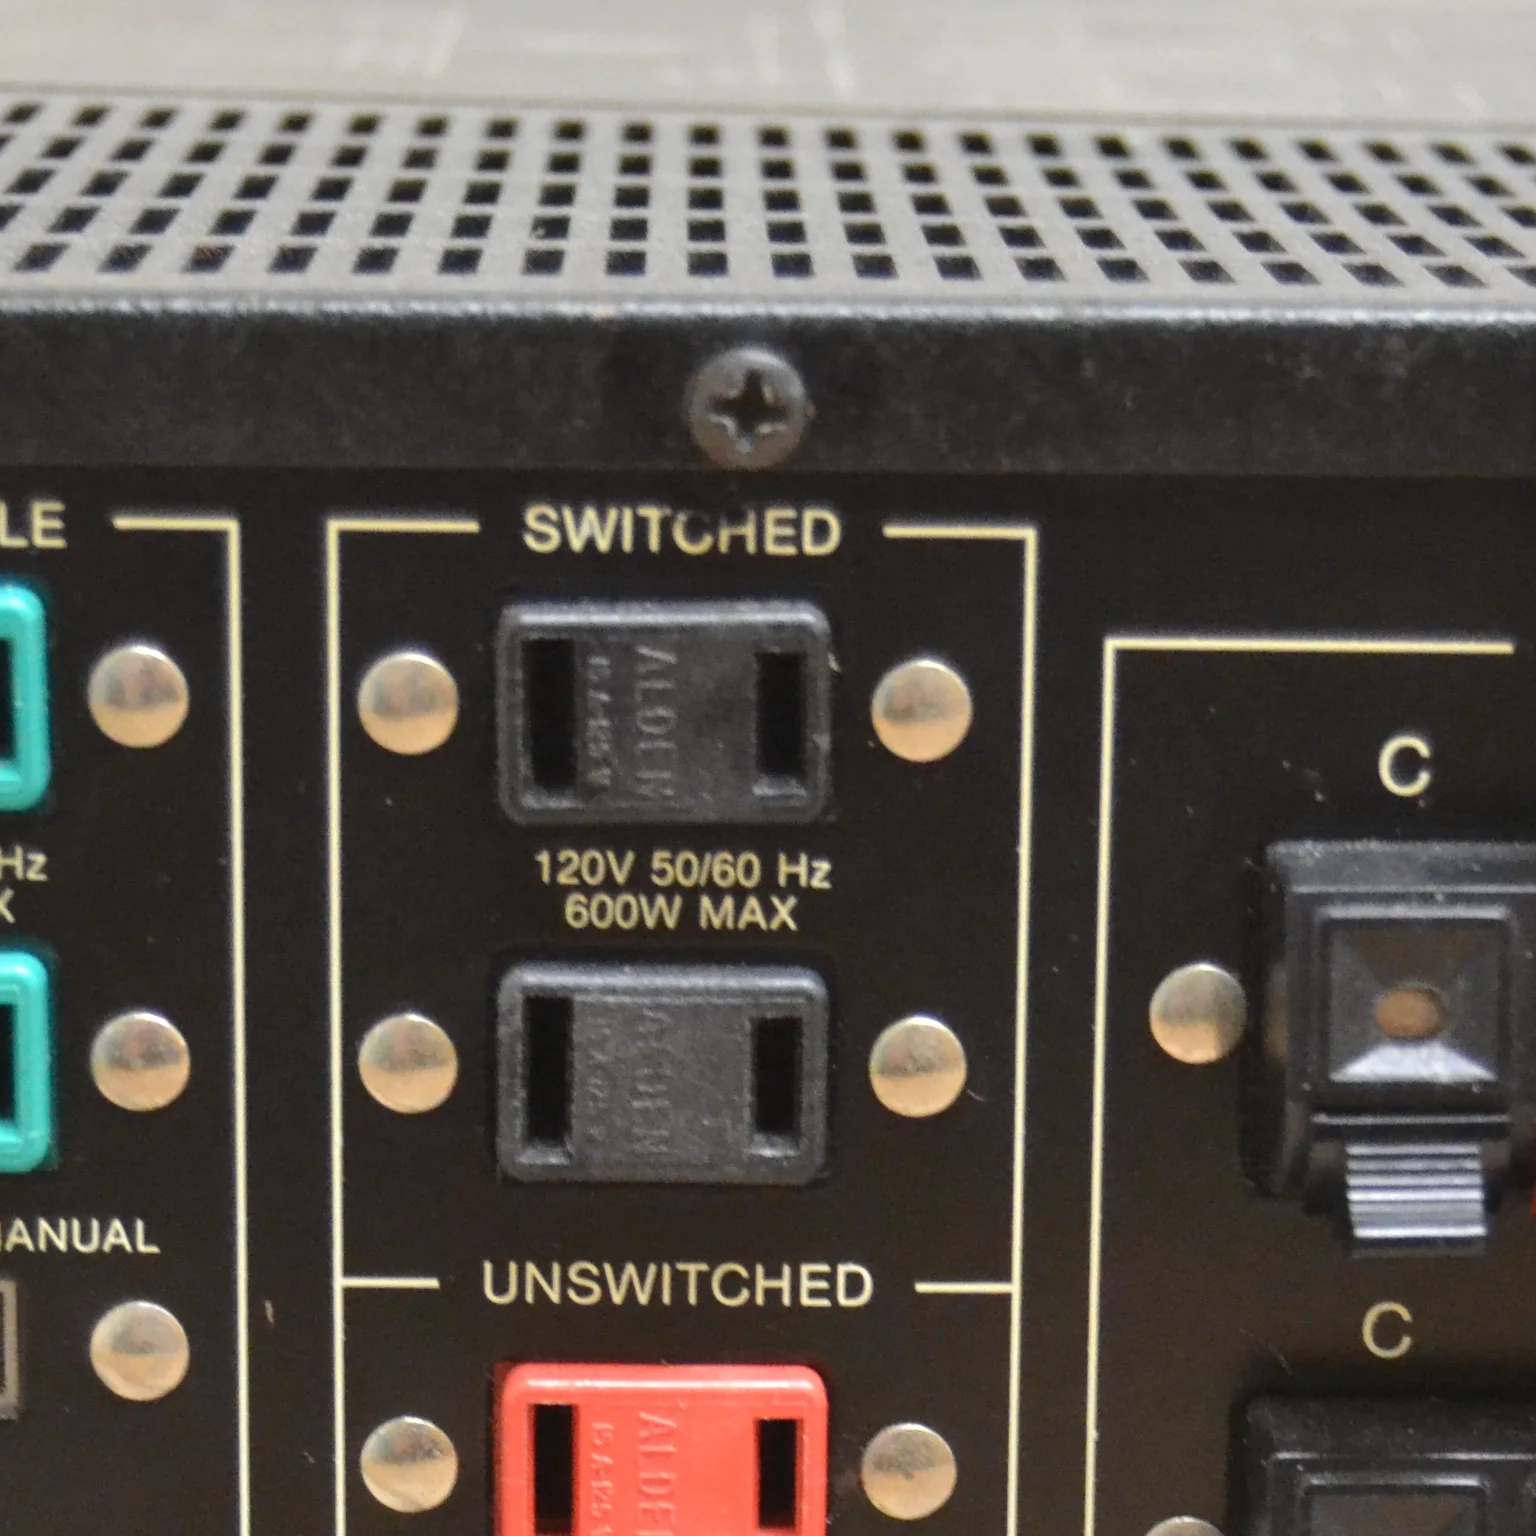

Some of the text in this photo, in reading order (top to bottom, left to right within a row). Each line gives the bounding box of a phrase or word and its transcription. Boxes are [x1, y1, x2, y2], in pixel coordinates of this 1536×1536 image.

[524, 504, 841, 555] SWITCHED
[1379, 735, 1430, 796] C
[536, 849, 831, 889] 120V 50/60 Hz
[565, 893, 797, 930] 600W MAX
[484, 1261, 873, 1307] UNSWITCHED
[1362, 1301, 1412, 1358] C
